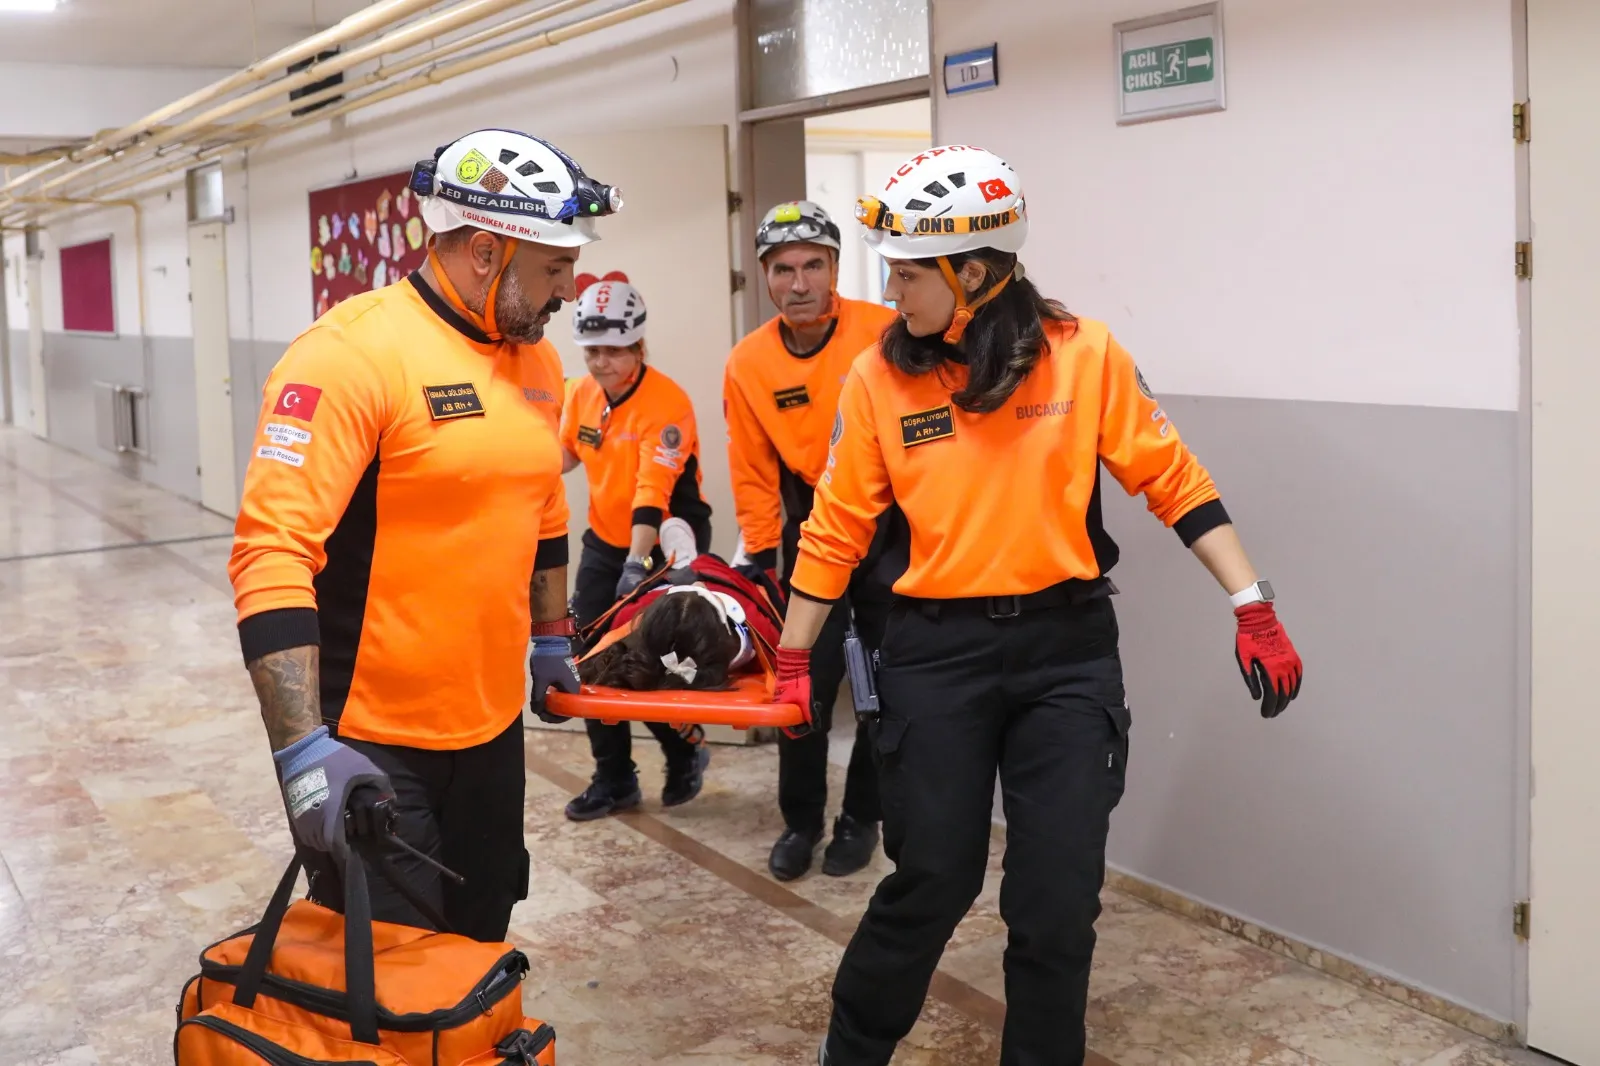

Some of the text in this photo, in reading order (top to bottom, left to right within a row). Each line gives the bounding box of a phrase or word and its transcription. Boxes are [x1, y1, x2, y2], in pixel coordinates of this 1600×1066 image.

[1128, 50, 1158, 70] ACİL
[961, 66, 979, 82] 1/D
[1125, 70, 1163, 92] ÇIKIŞ
[467, 194, 548, 215] HEADLIGH
[913, 217, 955, 233] ONG
[968, 210, 1010, 232] KONG
[442, 403, 453, 412] AB
[454, 402, 466, 410] Rh
[926, 410, 950, 421] UYGUR
[1016, 400, 1074, 420] BUCAKUT
[915, 430, 922, 438] A
[922, 427, 934, 436] Rh
